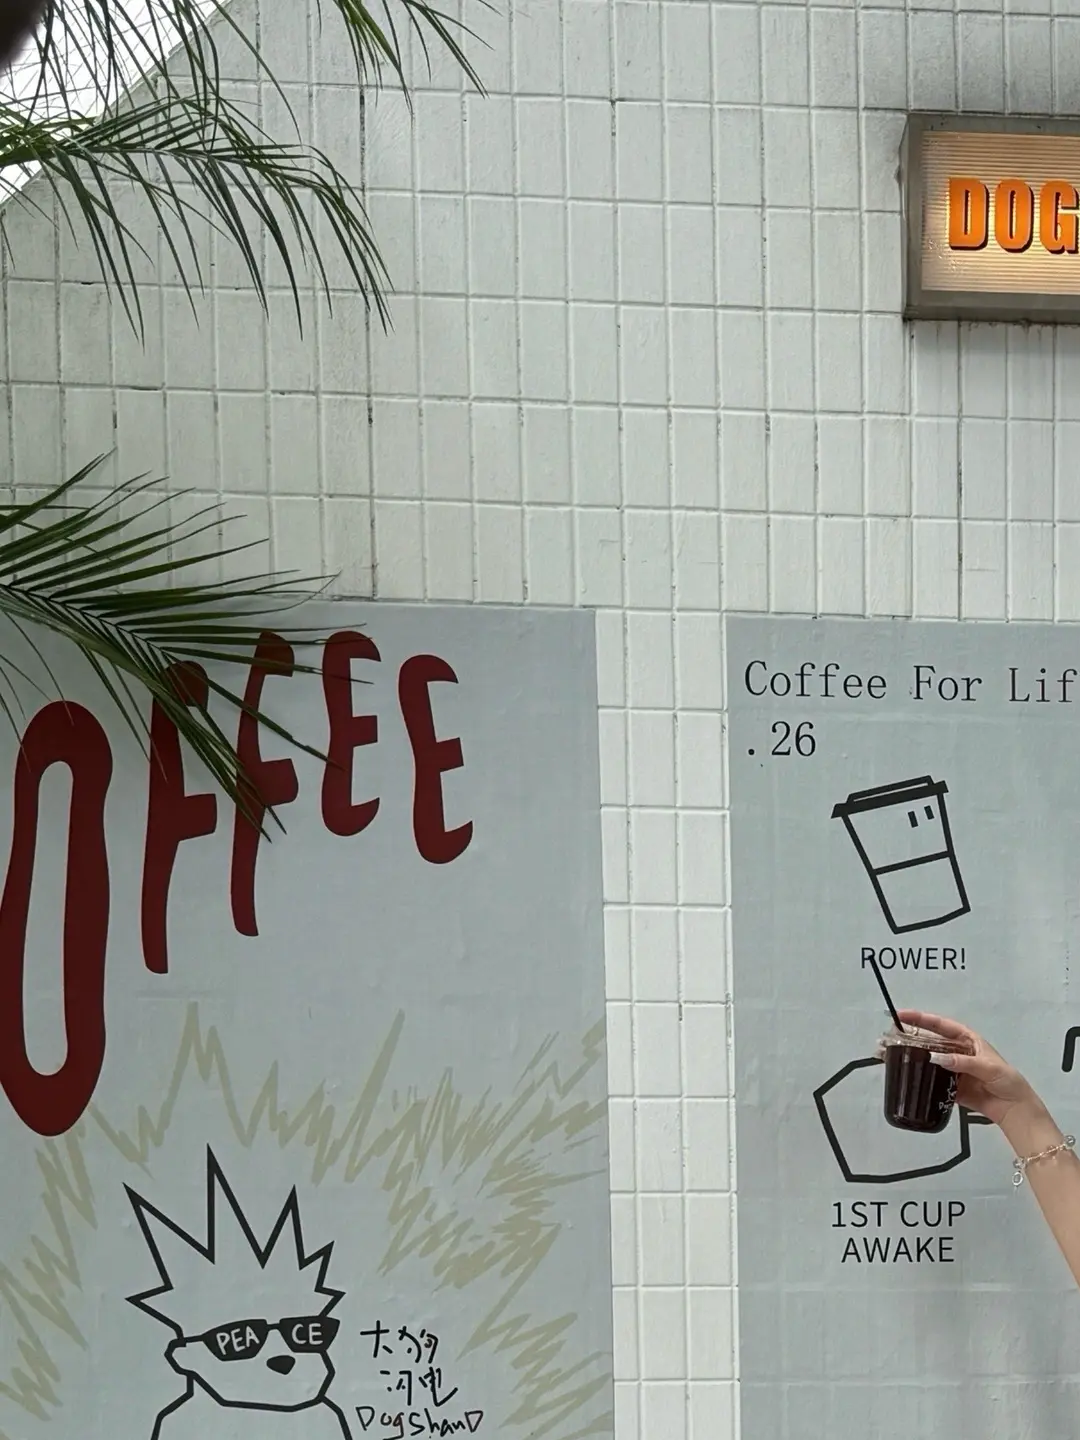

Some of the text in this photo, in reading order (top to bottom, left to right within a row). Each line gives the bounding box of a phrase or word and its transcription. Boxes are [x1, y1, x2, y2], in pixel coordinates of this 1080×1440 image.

[948, 177, 1079, 254] DOG
[745, 661, 886, 699] Coffee
[913, 666, 982, 701] For
[748, 721, 815, 756] .26
[861, 947, 966, 970] POWER!
[832, 1201, 965, 1227] 1ST CUP
[842, 1237, 954, 1263] AWAKE
[215, 1323, 323, 1353] PEA CE
